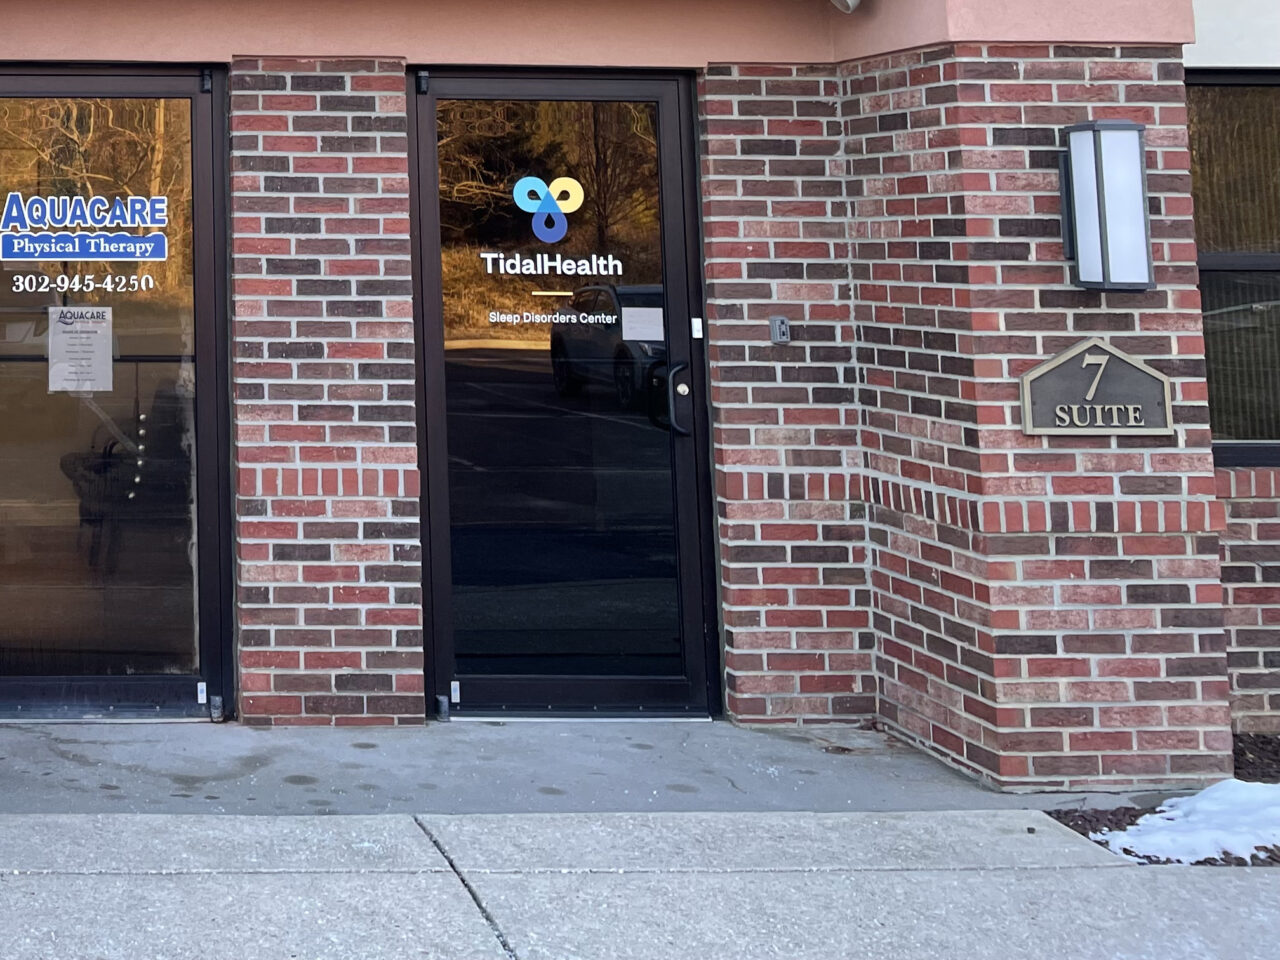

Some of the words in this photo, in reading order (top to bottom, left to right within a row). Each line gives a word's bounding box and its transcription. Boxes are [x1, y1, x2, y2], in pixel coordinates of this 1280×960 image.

[0, 192, 168, 231] AQUACARE
[12, 238, 80, 256] Physical
[86, 238, 155, 256] Therapy
[480, 252, 623, 276] TidalHealth
[12, 274, 154, 293] 302-945-4250
[58, 309, 107, 320] AQUACARE
[489, 311, 521, 325] Sleep
[522, 312, 577, 324] Disorders
[579, 312, 617, 324] Center
[1081, 353, 1110, 401] 7
[1055, 404, 1145, 427] SUITE
